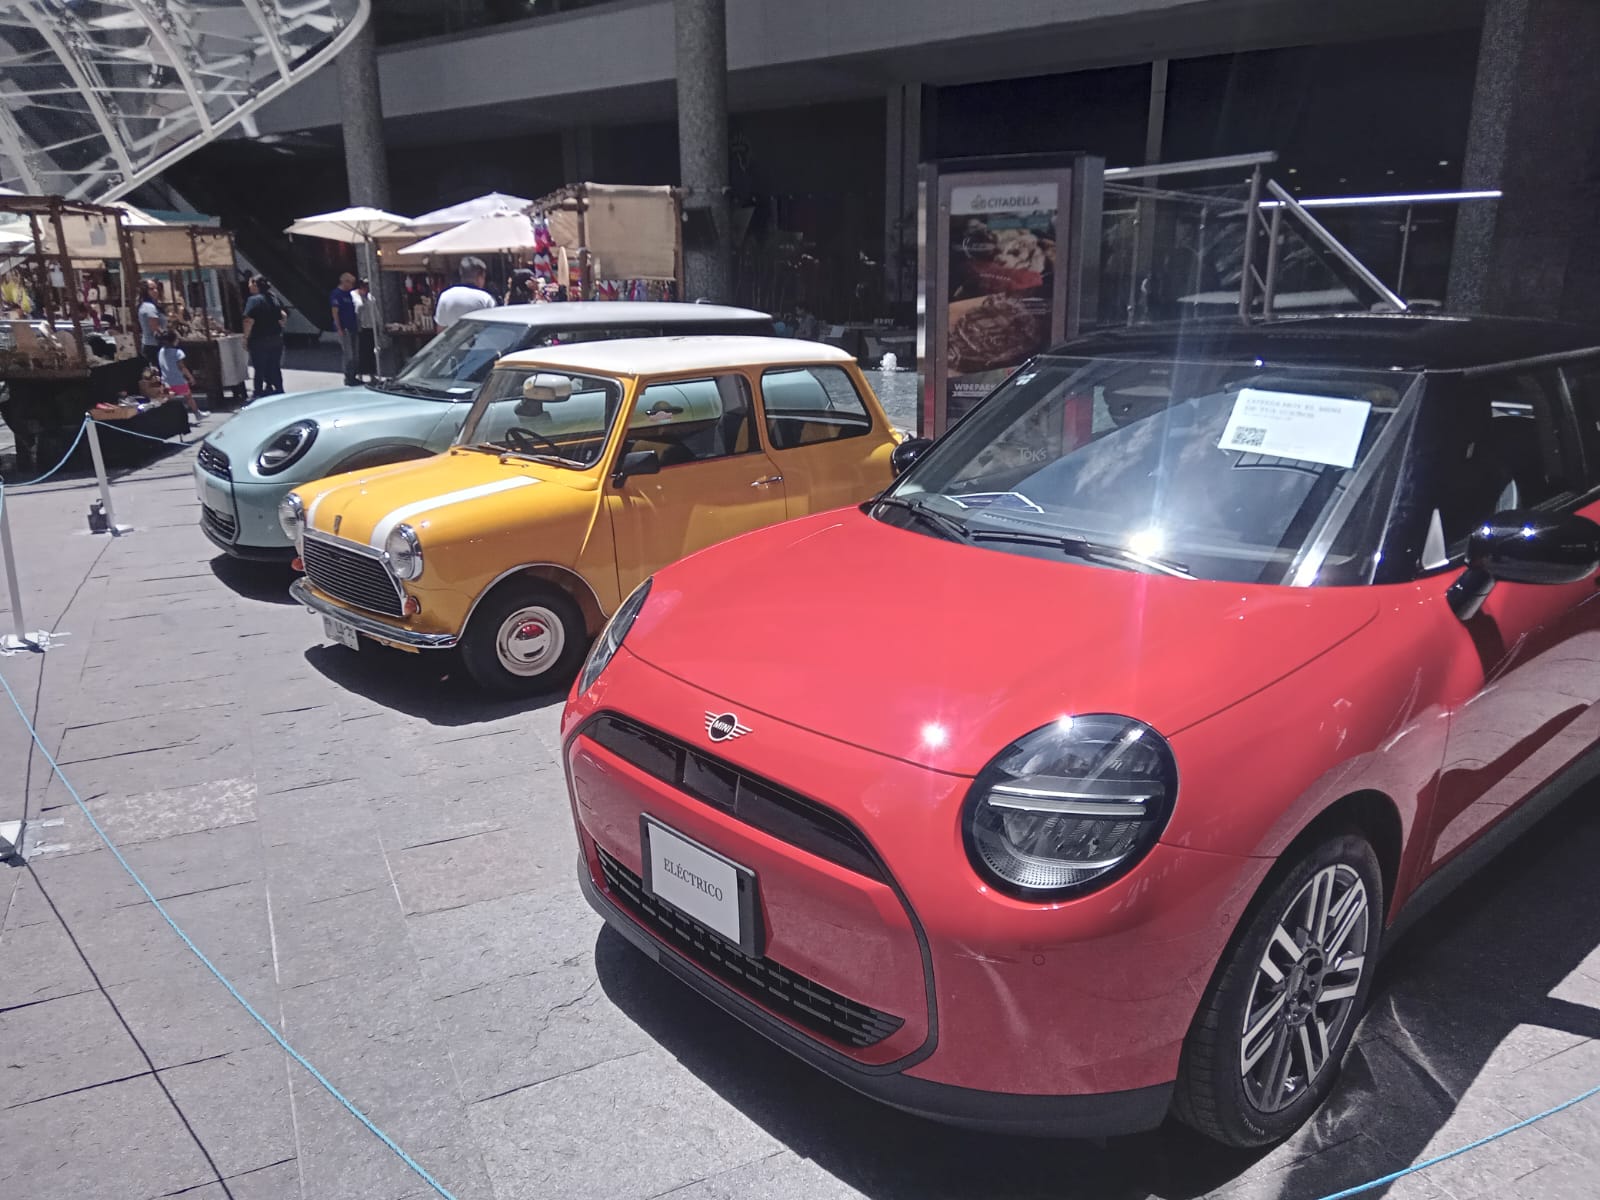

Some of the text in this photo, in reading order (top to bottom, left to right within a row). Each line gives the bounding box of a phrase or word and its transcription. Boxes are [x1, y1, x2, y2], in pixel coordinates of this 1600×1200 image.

[987, 195, 1040, 209] CITADELLA
[712, 720, 733, 734] MINI
[663, 857, 723, 902] ELÉCTRICO
